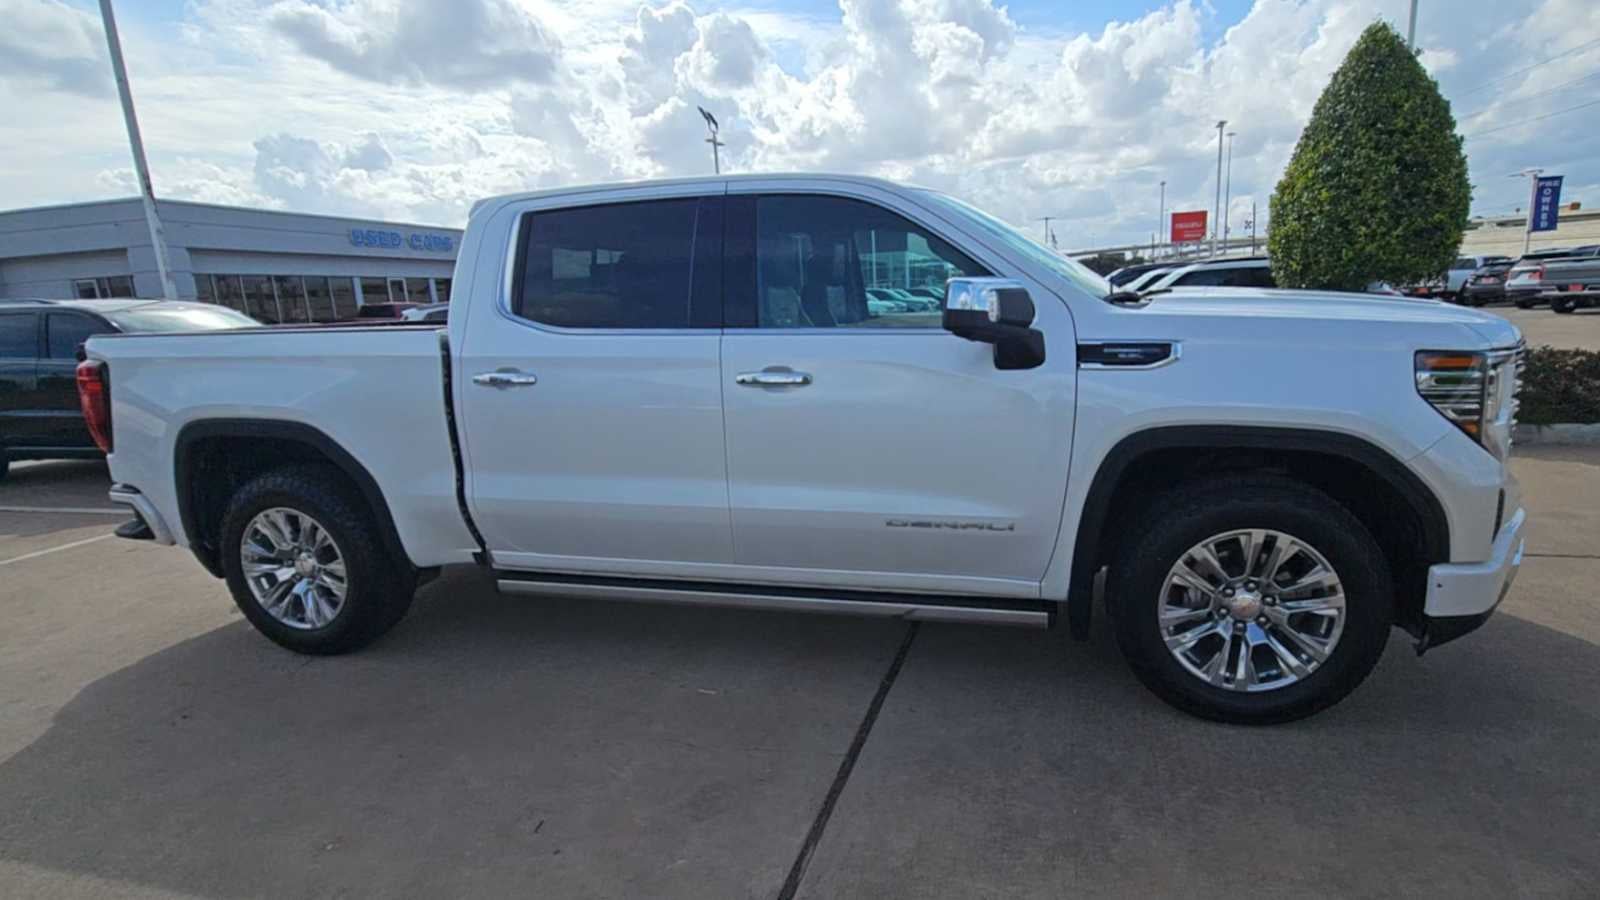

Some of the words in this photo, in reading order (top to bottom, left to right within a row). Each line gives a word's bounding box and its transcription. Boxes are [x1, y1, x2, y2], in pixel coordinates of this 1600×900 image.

[1540, 187, 1552, 228] OWNED
[350, 229, 401, 248] USED
[410, 232, 453, 252] CARS
[885, 519, 1015, 532] DENALI
